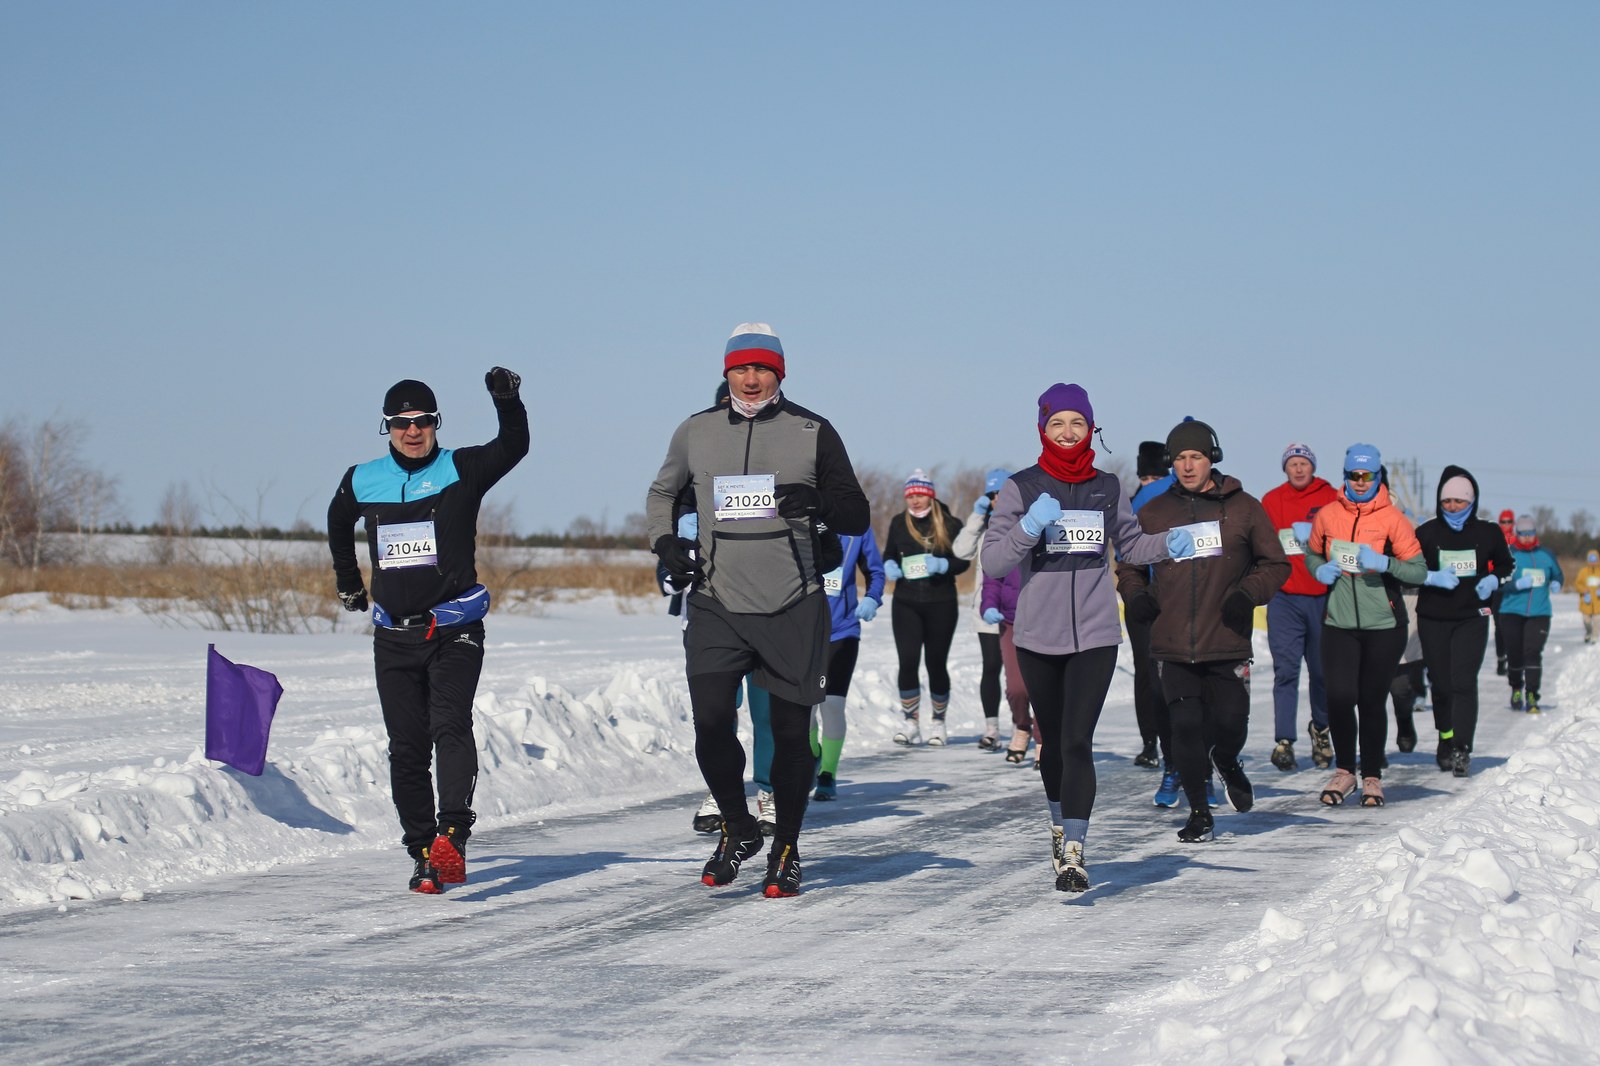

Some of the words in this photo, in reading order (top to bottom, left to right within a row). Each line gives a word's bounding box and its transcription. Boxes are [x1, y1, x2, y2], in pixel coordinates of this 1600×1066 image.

[725, 494, 771, 508] 21020
[1059, 529, 1102, 542] 21022
[1196, 536, 1219, 548] 031
[387, 541, 431, 556] 21044
